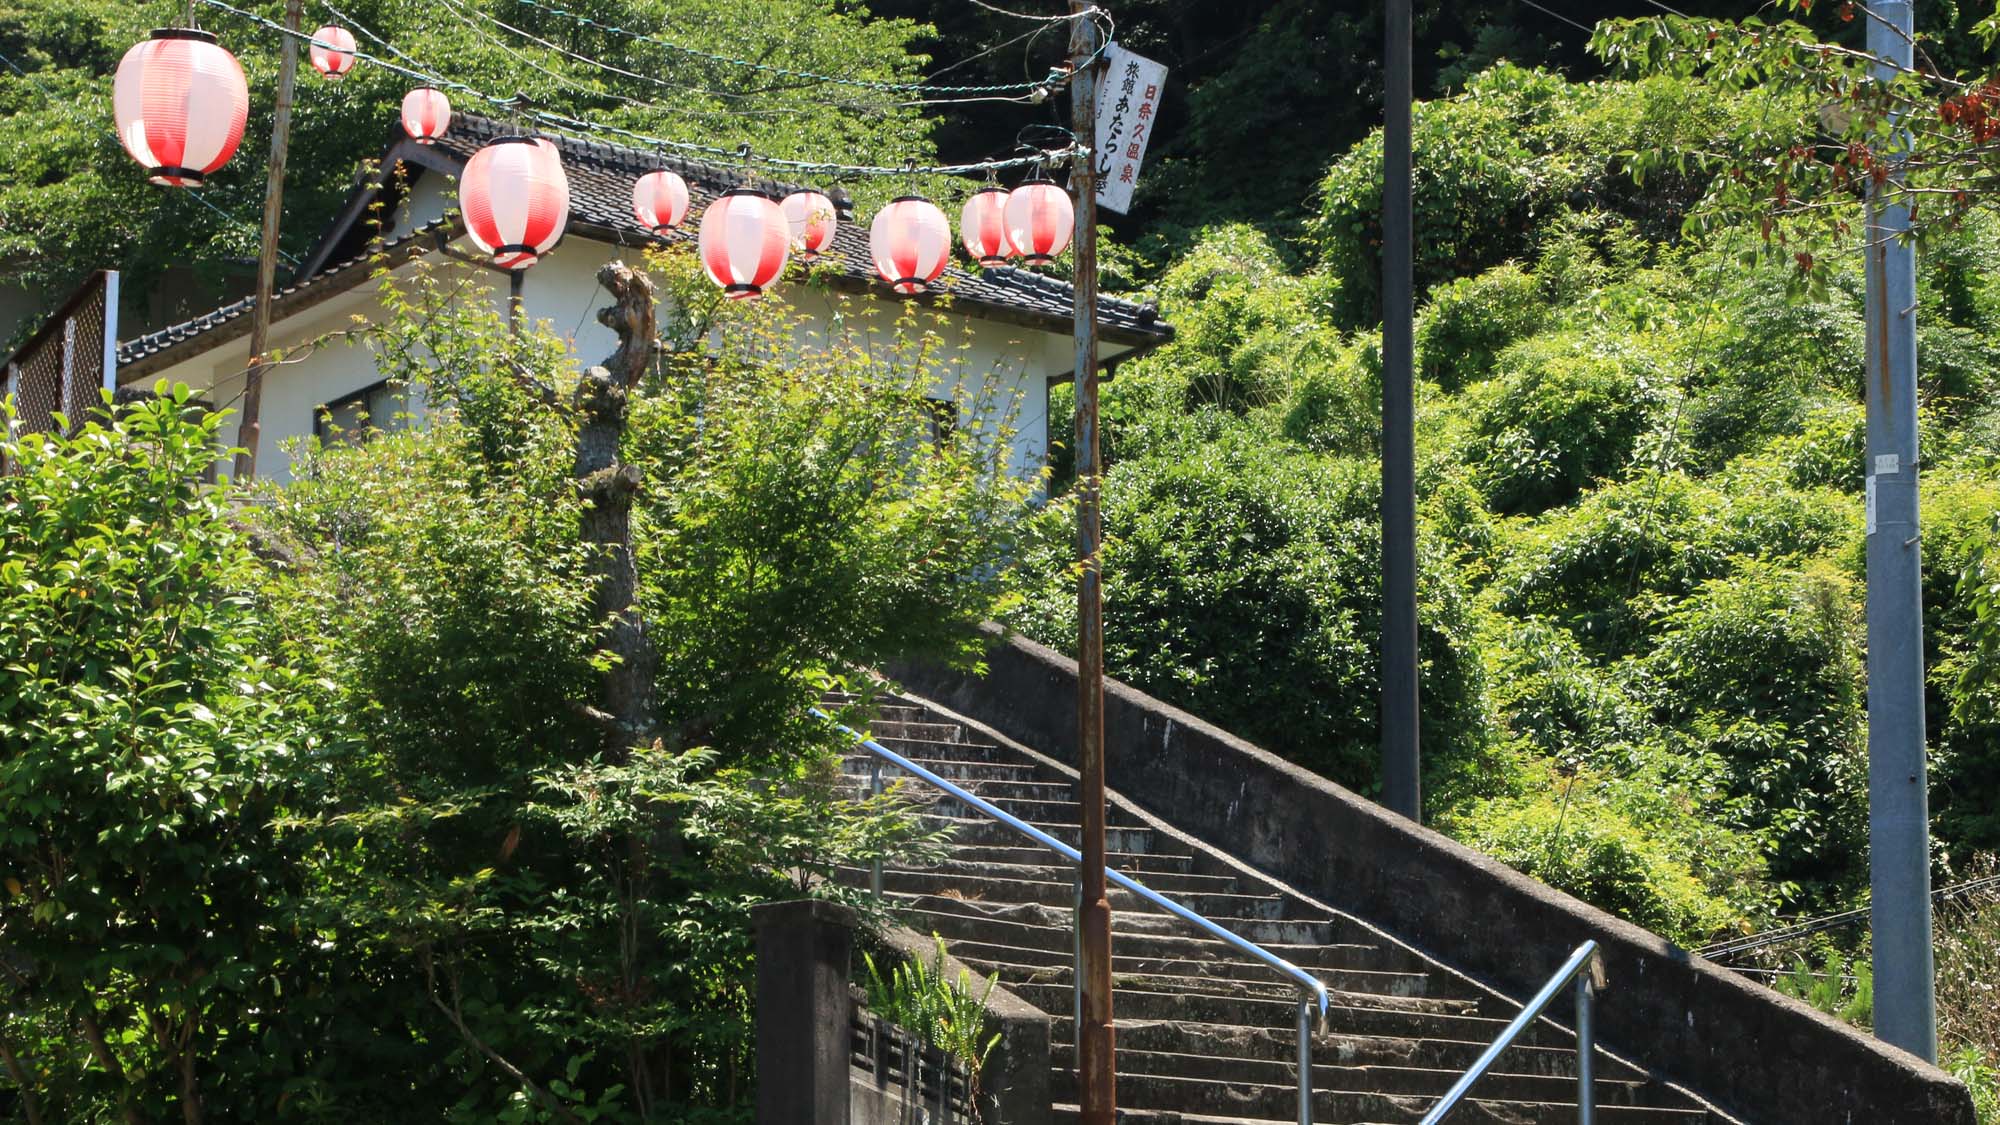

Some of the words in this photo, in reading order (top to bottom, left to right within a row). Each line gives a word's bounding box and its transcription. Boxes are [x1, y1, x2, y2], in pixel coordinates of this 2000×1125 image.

[1119, 84, 1157, 184] 日奈久温泉
